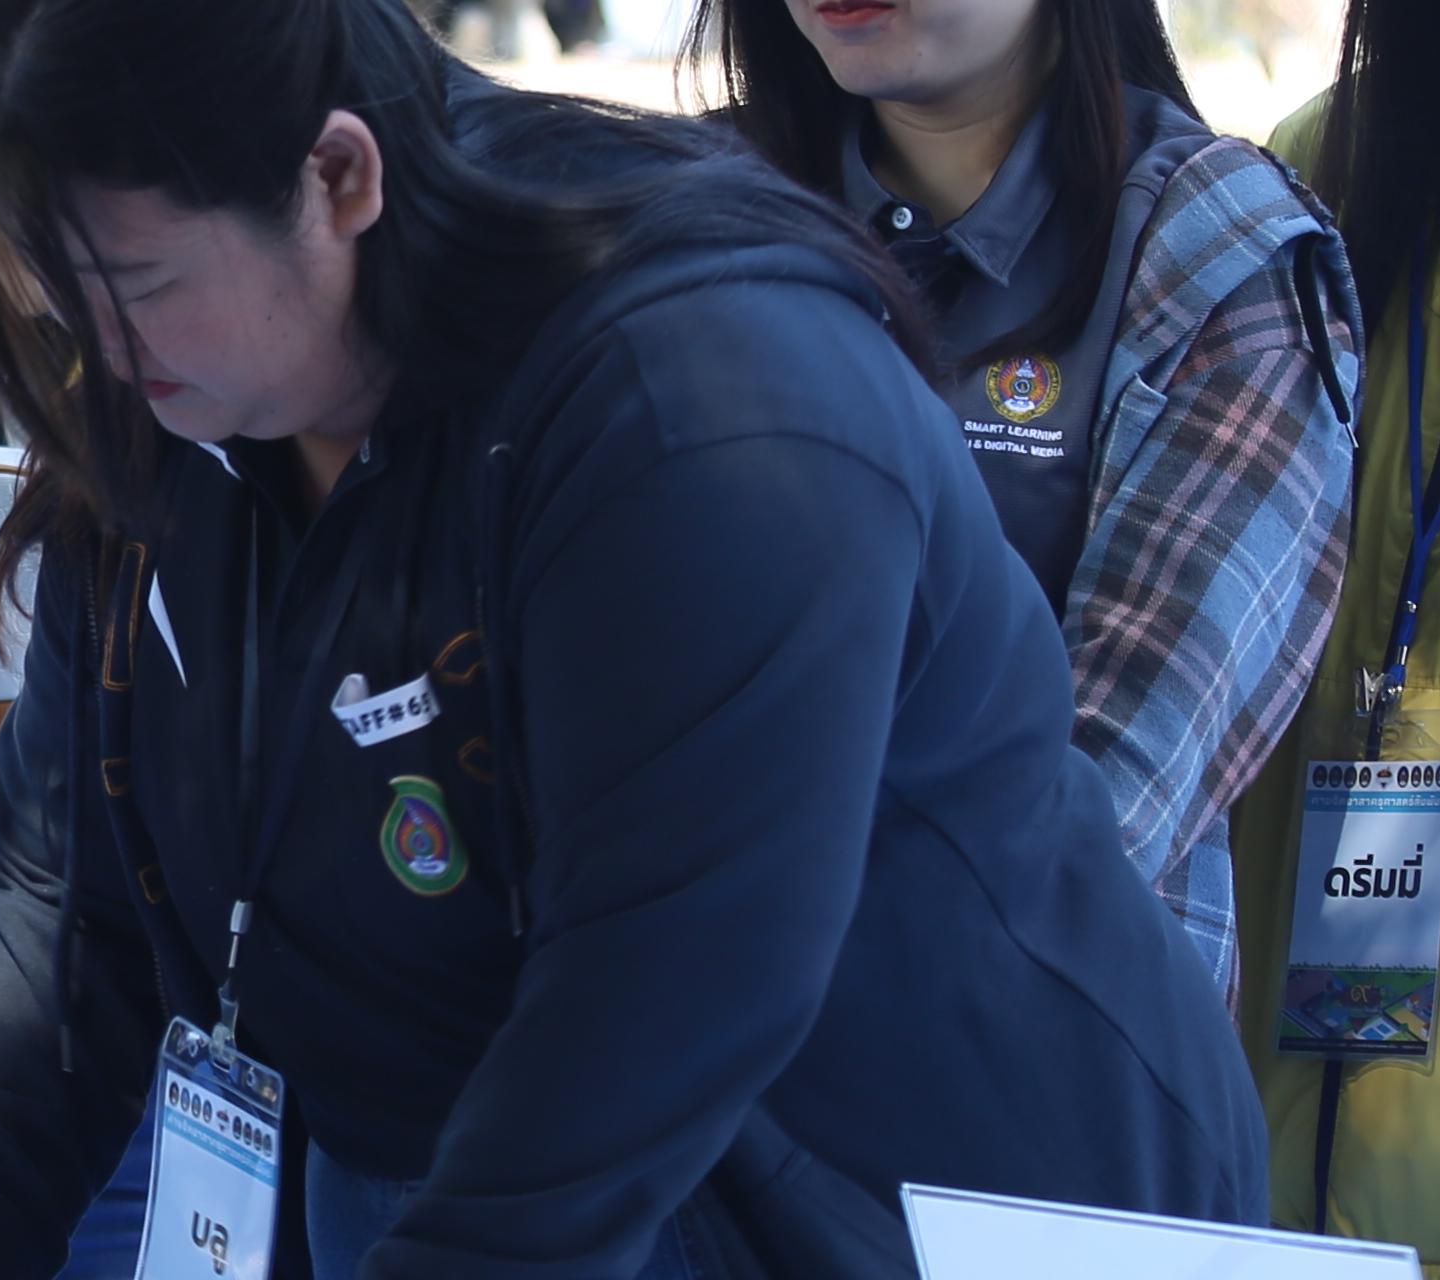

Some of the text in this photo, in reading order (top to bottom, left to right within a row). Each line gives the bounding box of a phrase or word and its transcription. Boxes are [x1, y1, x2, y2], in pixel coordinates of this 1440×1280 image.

[964, 420, 1063, 441] SMART LEARNING
[973, 439, 983, 449] &
[984, 440, 1028, 454] DIGITAL
[1030, 445, 1064, 458] MEDIA
[1323, 843, 1424, 899] ดรีมมี่
